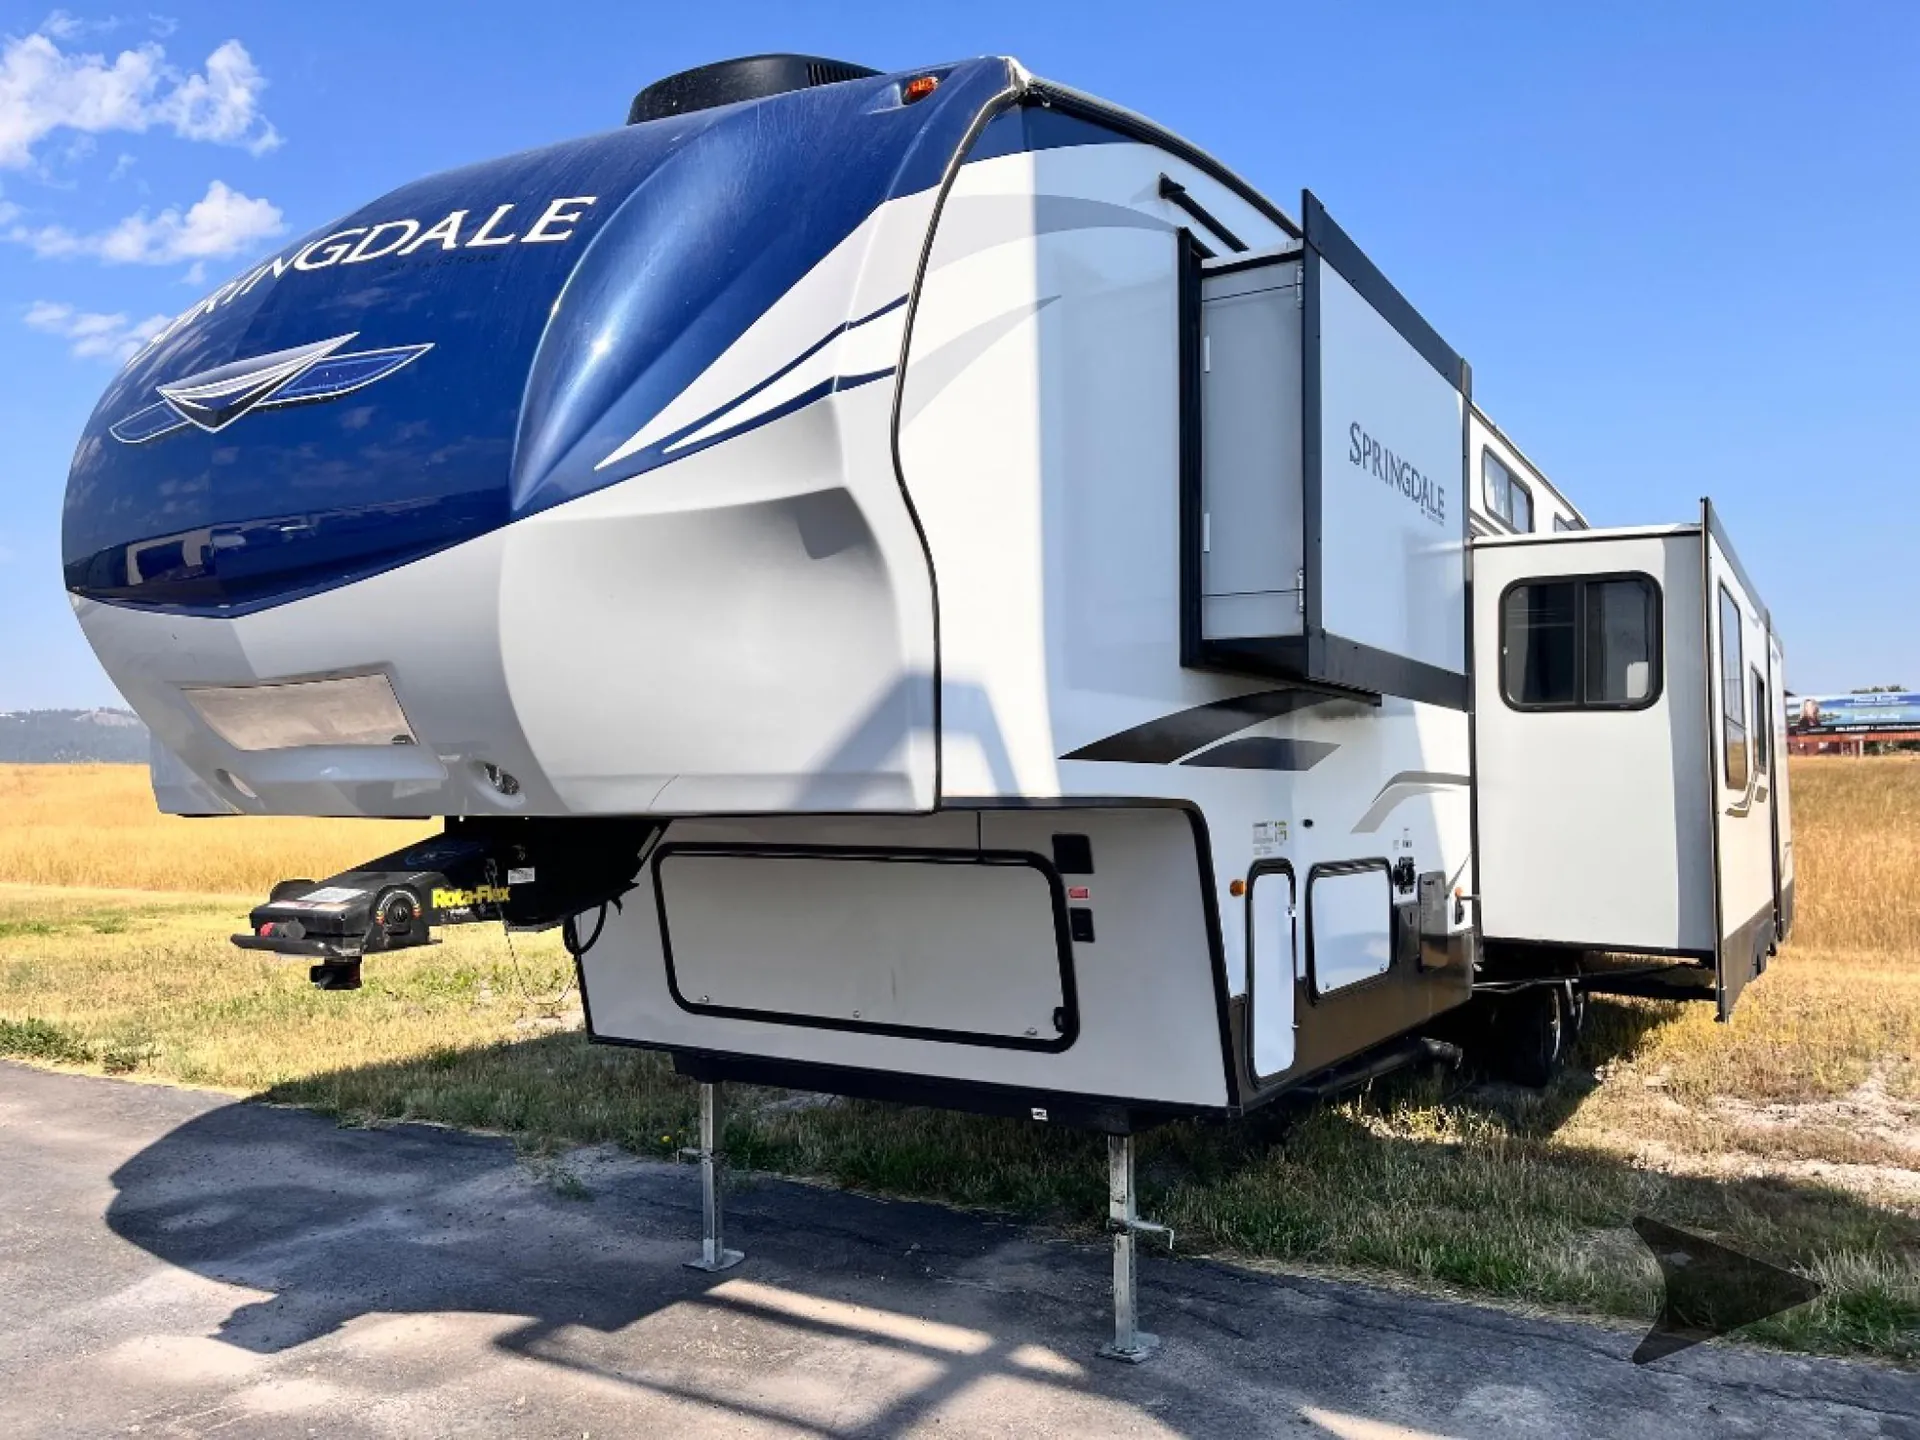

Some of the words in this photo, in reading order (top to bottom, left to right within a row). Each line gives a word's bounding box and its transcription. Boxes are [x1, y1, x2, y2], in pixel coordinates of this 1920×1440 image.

[126, 196, 598, 368] RINGDALE
[1349, 421, 1445, 520] SPRINGDALE
[431, 885, 511, 909] Rota-Flex
